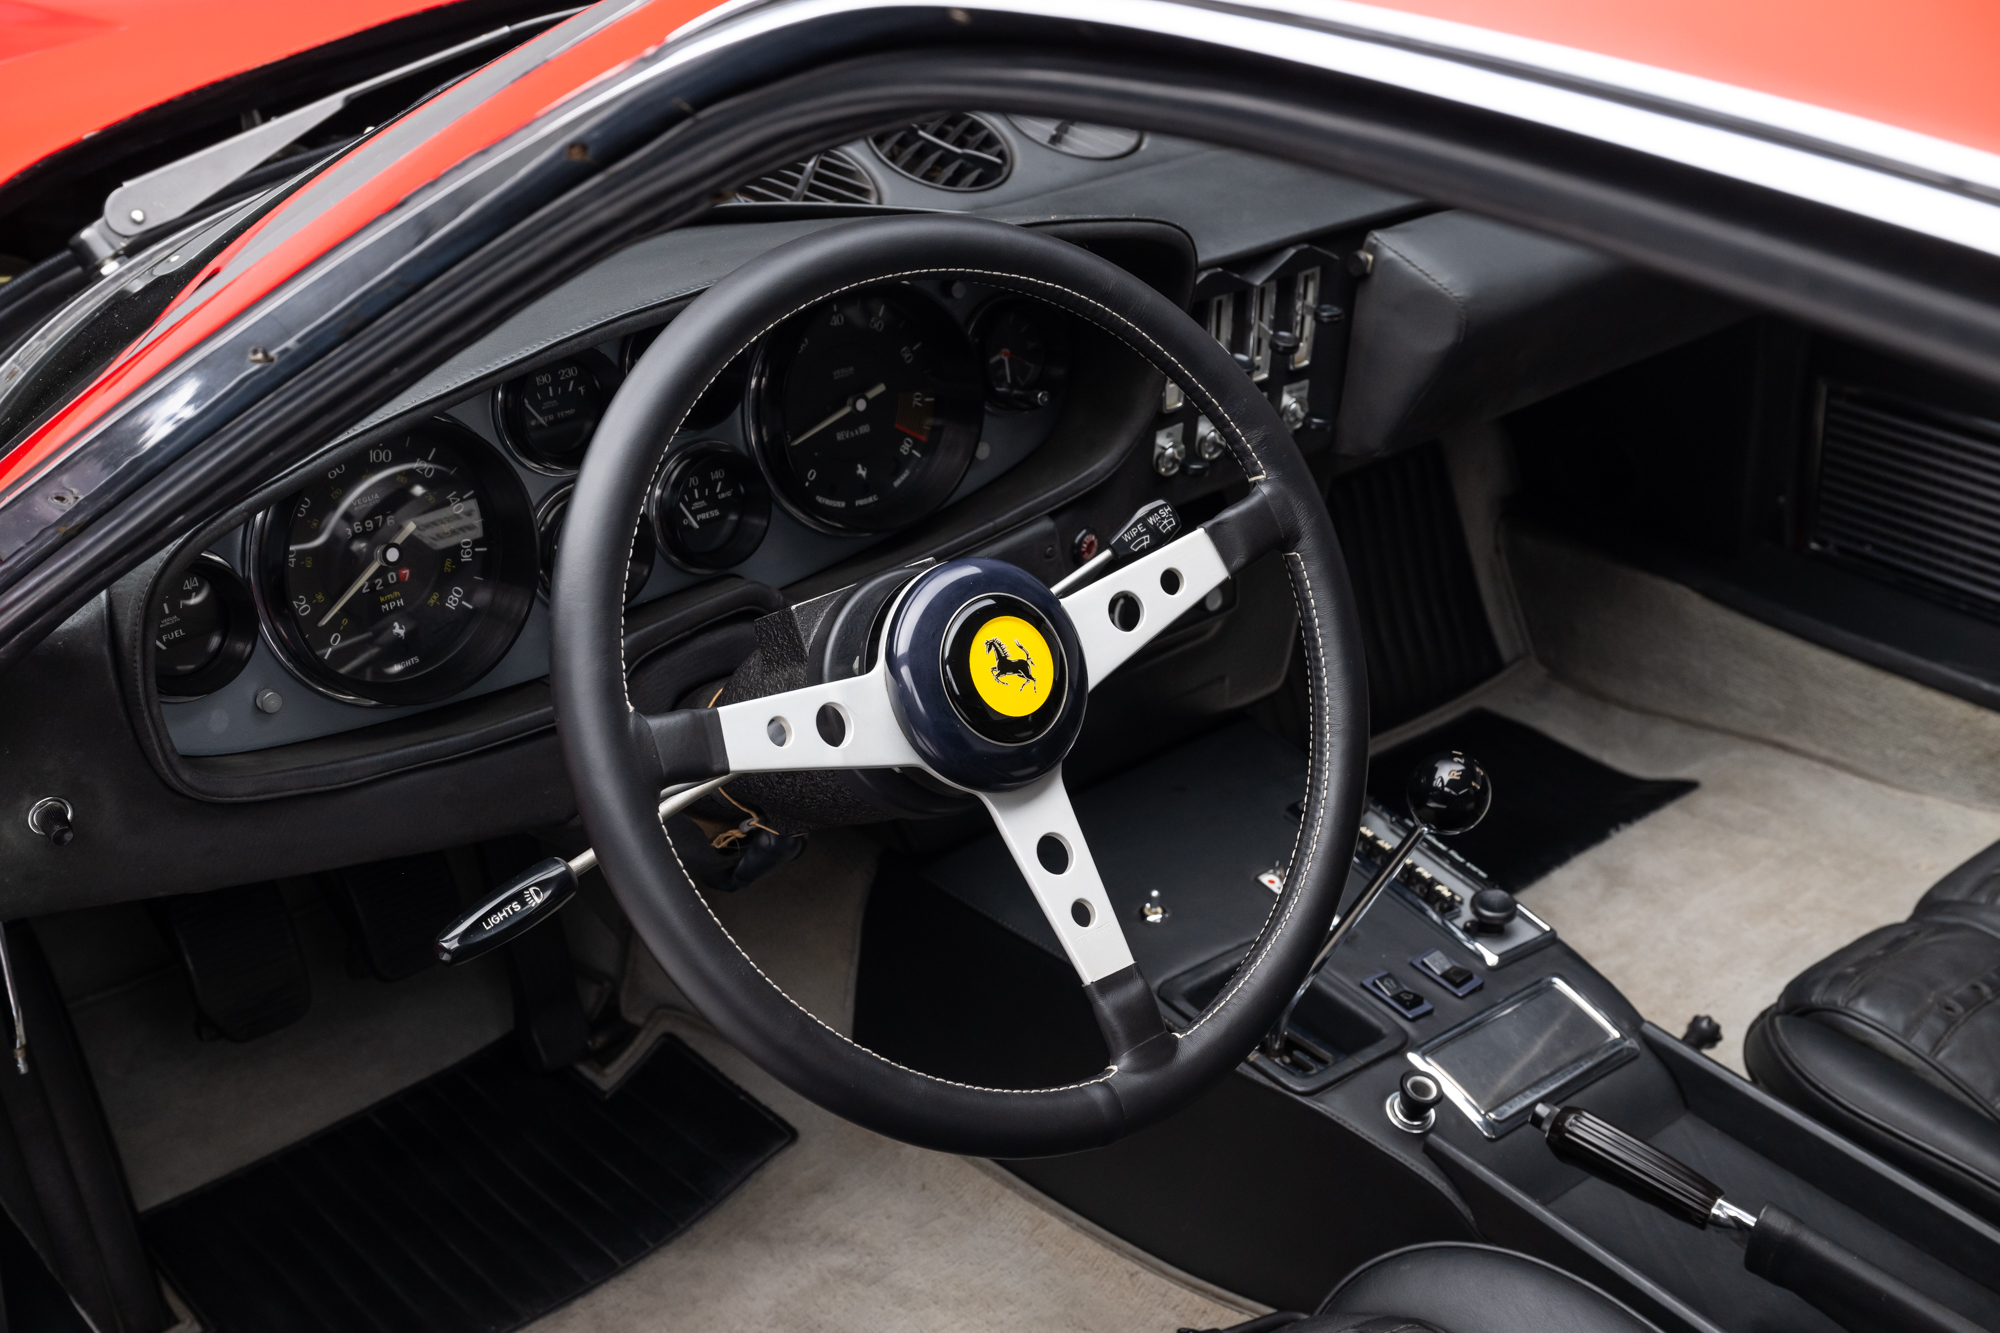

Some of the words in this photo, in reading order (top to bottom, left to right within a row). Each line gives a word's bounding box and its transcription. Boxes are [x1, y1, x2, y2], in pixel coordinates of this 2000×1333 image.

[830, 314, 844, 326] 40
[869, 316, 884, 332] 50
[900, 346, 914, 364] 60
[535, 373, 552, 386] 190
[558, 366, 578, 380] 230
[912, 392, 923, 408] 70
[899, 437, 914, 456] 80
[369, 449, 392, 463] 100
[414, 458, 435, 478] 120
[710, 469, 725, 481] 140
[807, 468, 817, 481] 0
[689, 476, 699, 488] 70
[351, 493, 380, 506] VEGLIA
[446, 491, 464, 514] 140
[696, 509, 720, 521] PRESS
[1121, 522, 1146, 542] WIPE
[1146, 505, 1172, 526] WASH
[460, 538, 473, 562] 160
[182, 576, 199, 590] 4/4
[379, 591, 401, 603] km/h
[445, 586, 464, 610] 180
[292, 595, 311, 616] 20
[381, 598, 404, 613] MPH
[162, 629, 186, 642] FUEL
[330, 632, 341, 646] 0
[1448, 770, 1462, 780] R
[482, 901, 521, 930] LIGHTS
